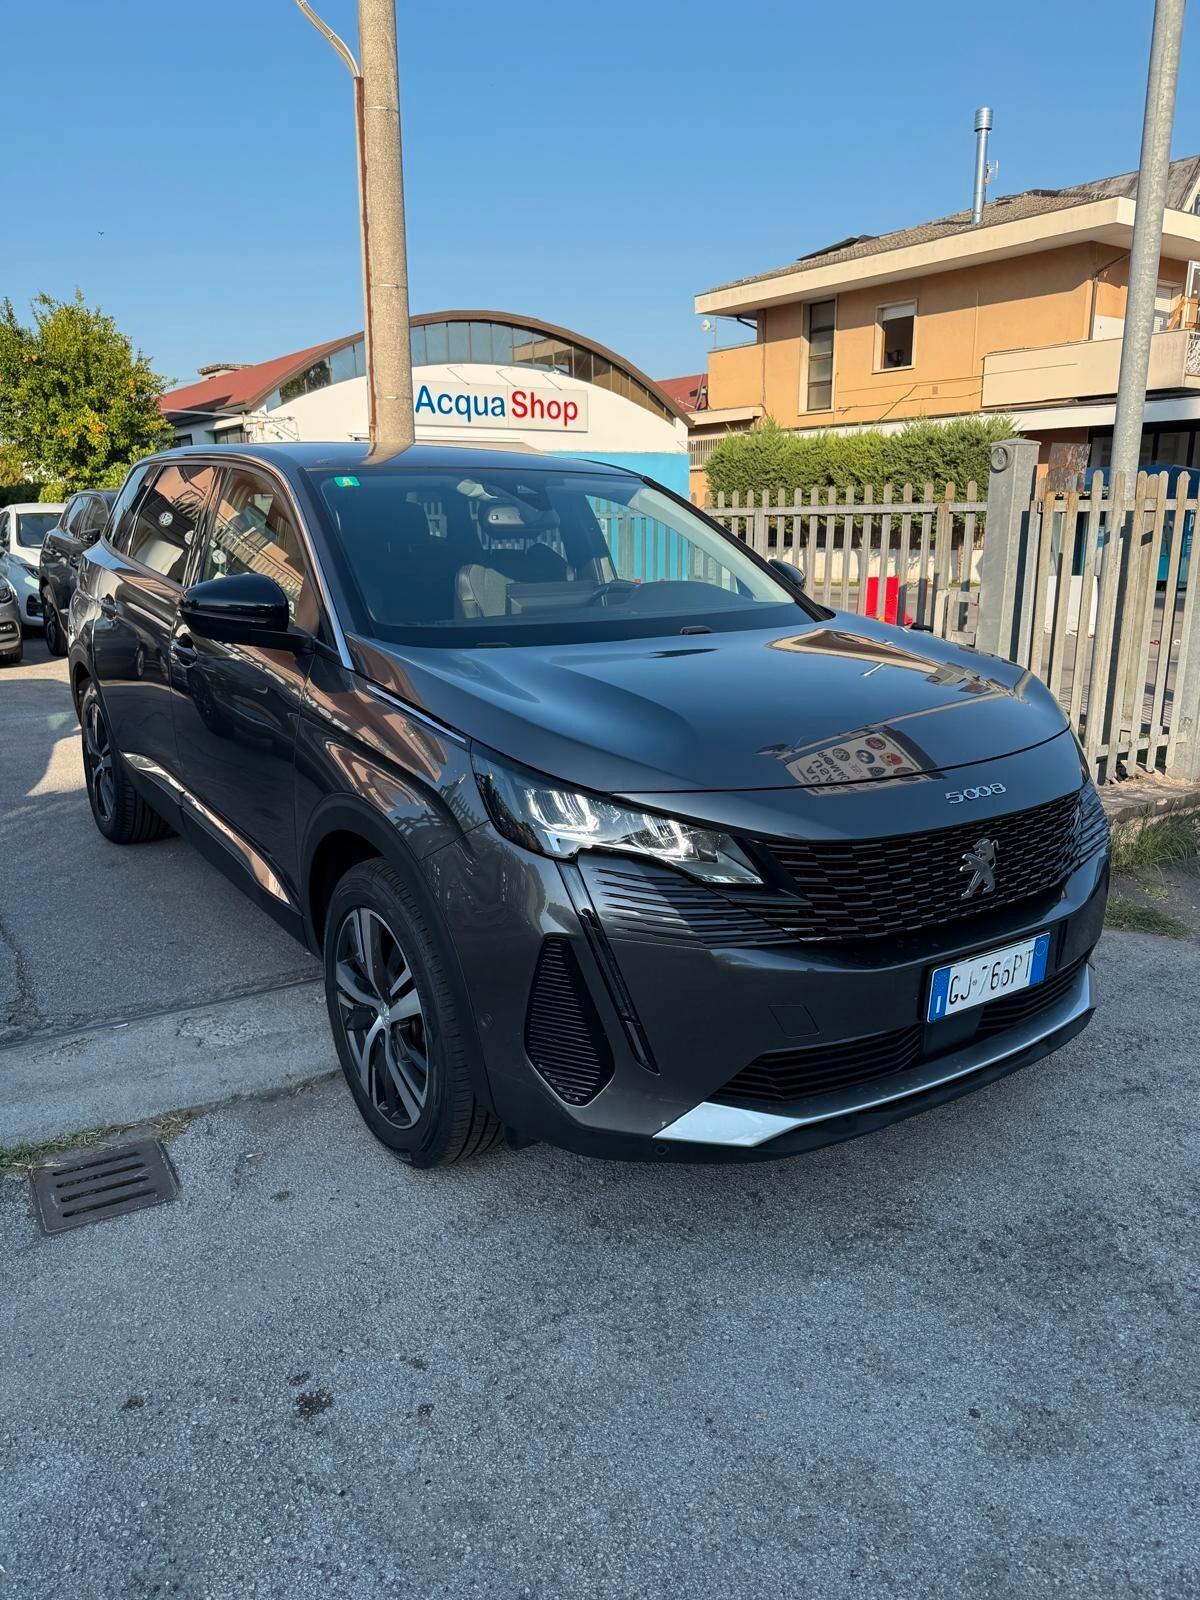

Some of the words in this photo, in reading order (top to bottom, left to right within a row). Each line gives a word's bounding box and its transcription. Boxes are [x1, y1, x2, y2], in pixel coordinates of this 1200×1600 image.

[415, 385, 506, 422] Acqua
[511, 390, 578, 427] Shop
[945, 782, 1007, 804] 5008
